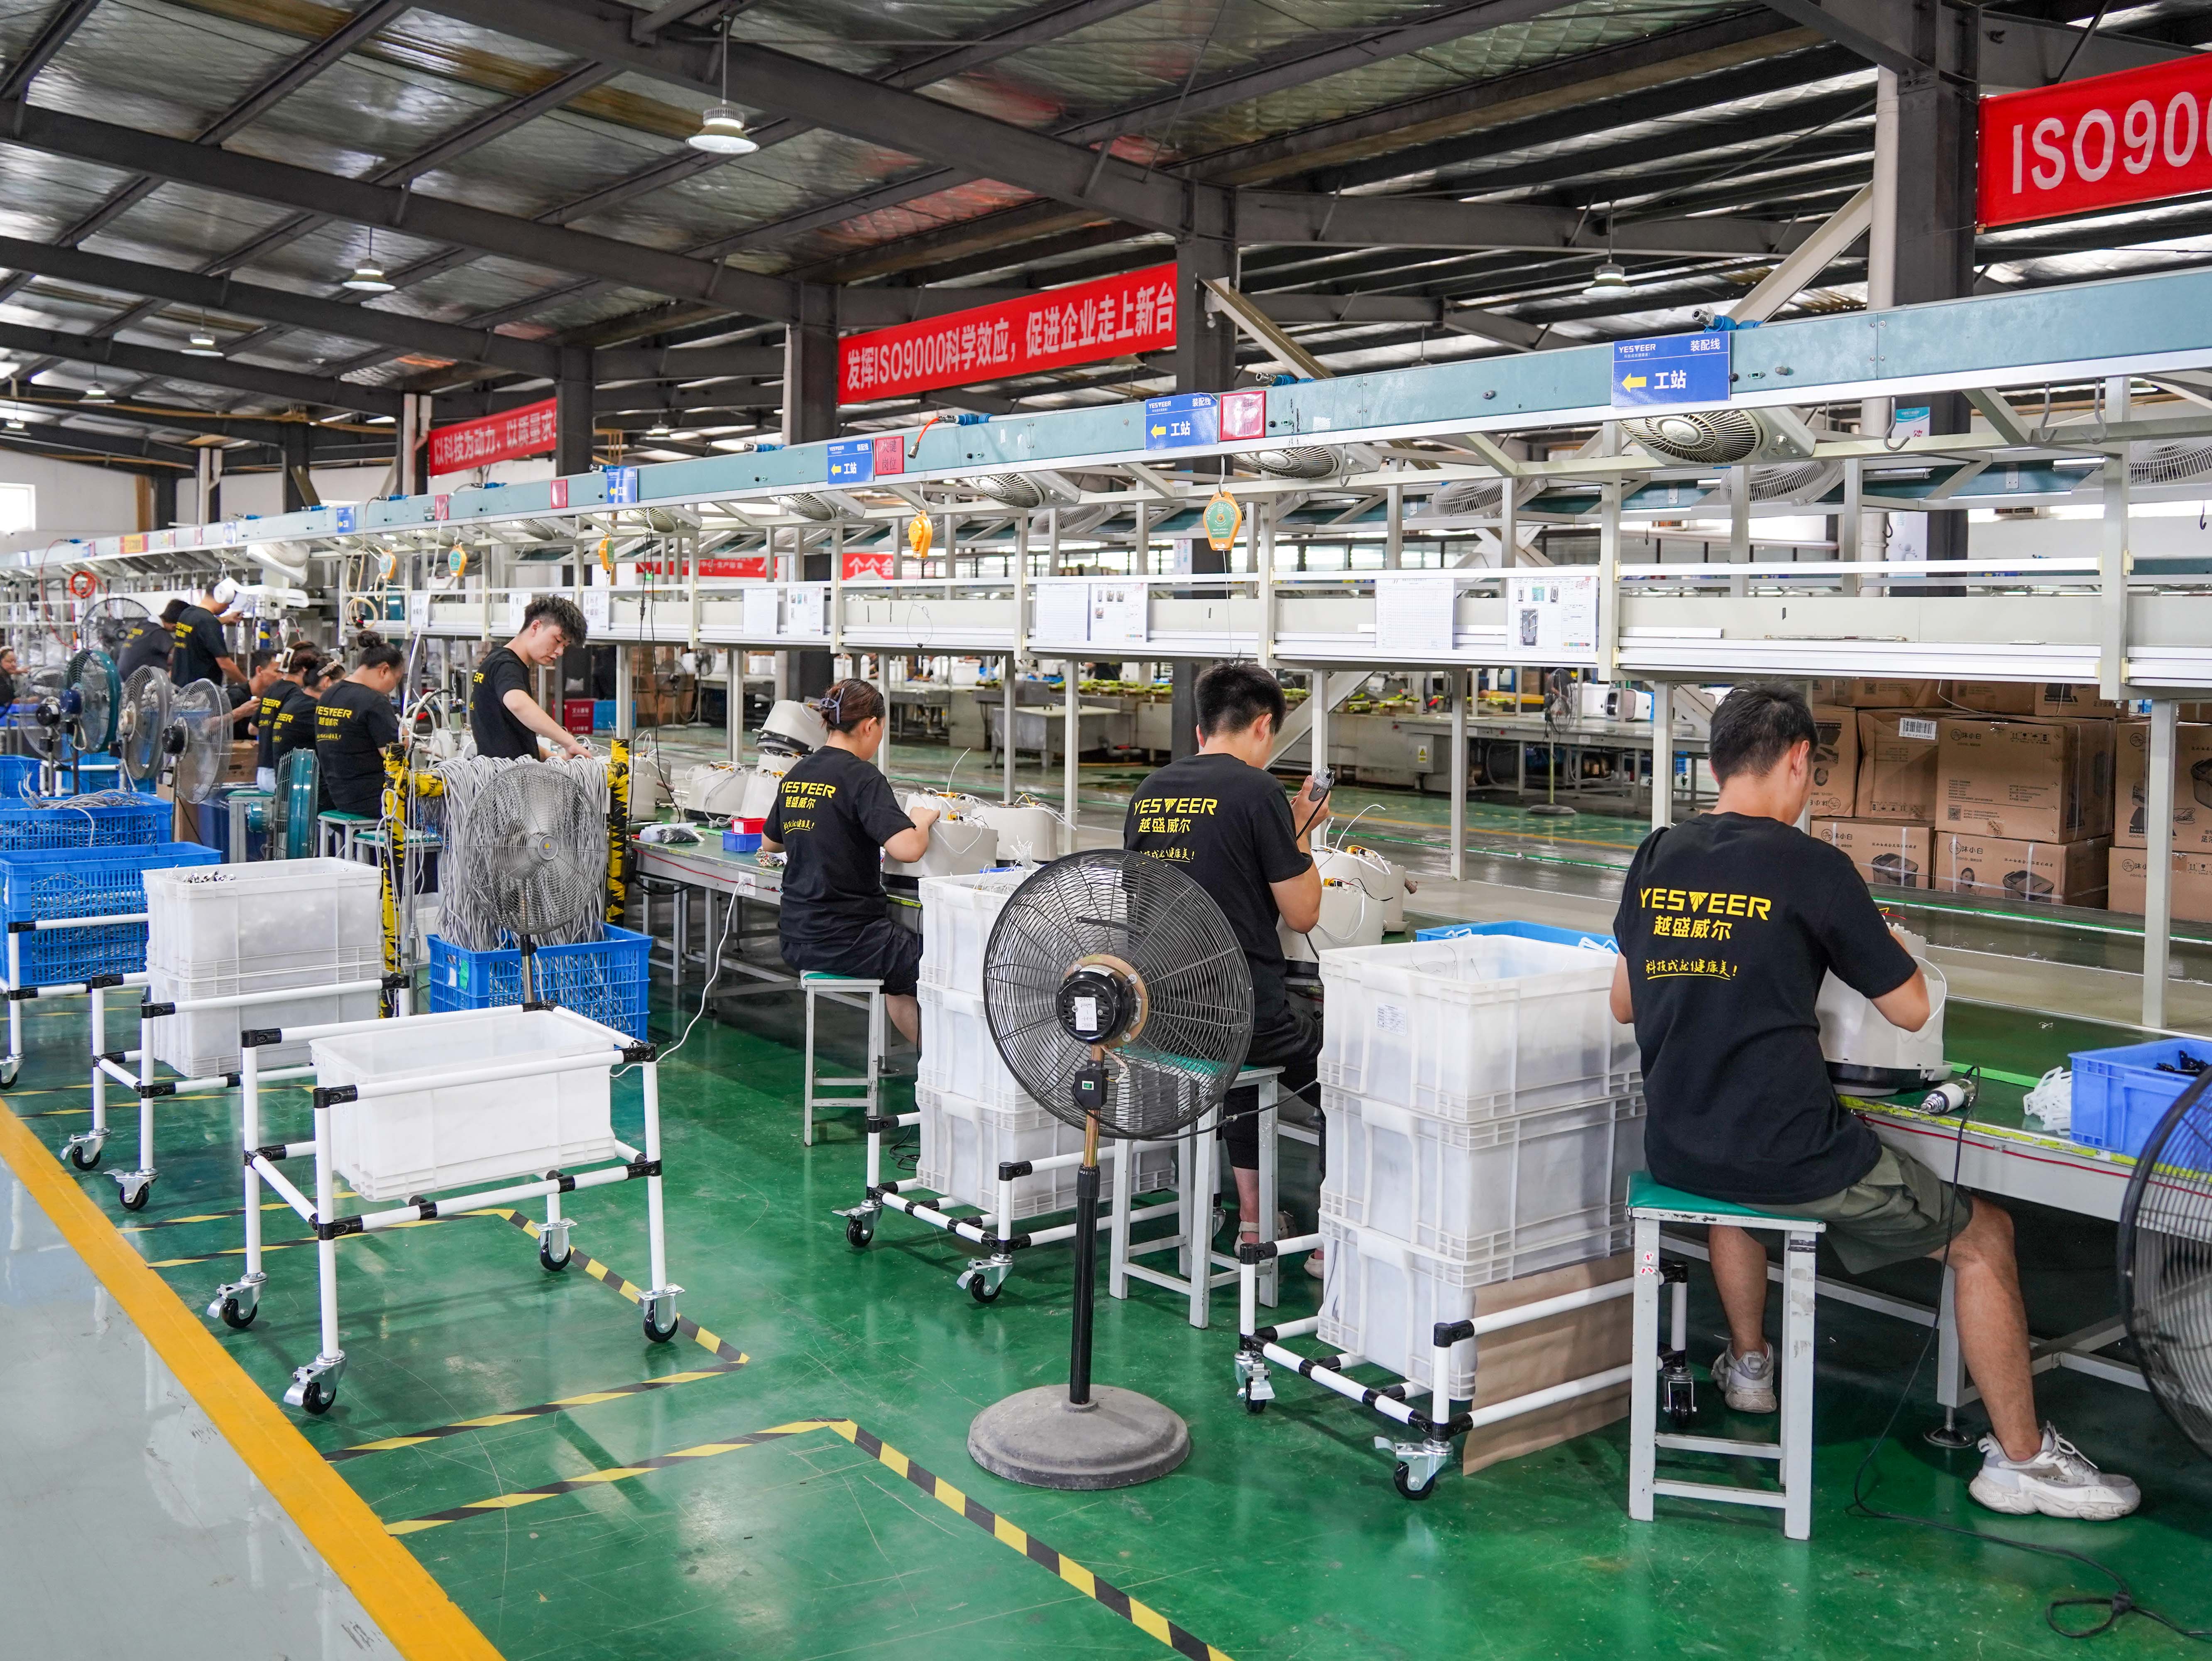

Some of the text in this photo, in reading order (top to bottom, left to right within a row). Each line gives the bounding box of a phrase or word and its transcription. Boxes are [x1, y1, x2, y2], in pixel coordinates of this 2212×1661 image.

[2012, 92, 2212, 194] ISO90
[1690, 338, 1720, 352] 装配线
[1654, 370, 1687, 390] 工站
[1192, 397, 1211, 407] 装配线
[1170, 421, 1191, 436] 工站
[434, 409, 556, 465] 以科技为动力，以质量求
[843, 462, 857, 474] 工站
[785, 796, 816, 810] 越盛威尔
[1138, 817, 1192, 833] 越盛威尔
[1961, 845, 1983, 854] 沐小白
[1653, 915, 1733, 941] 越盛威尔
